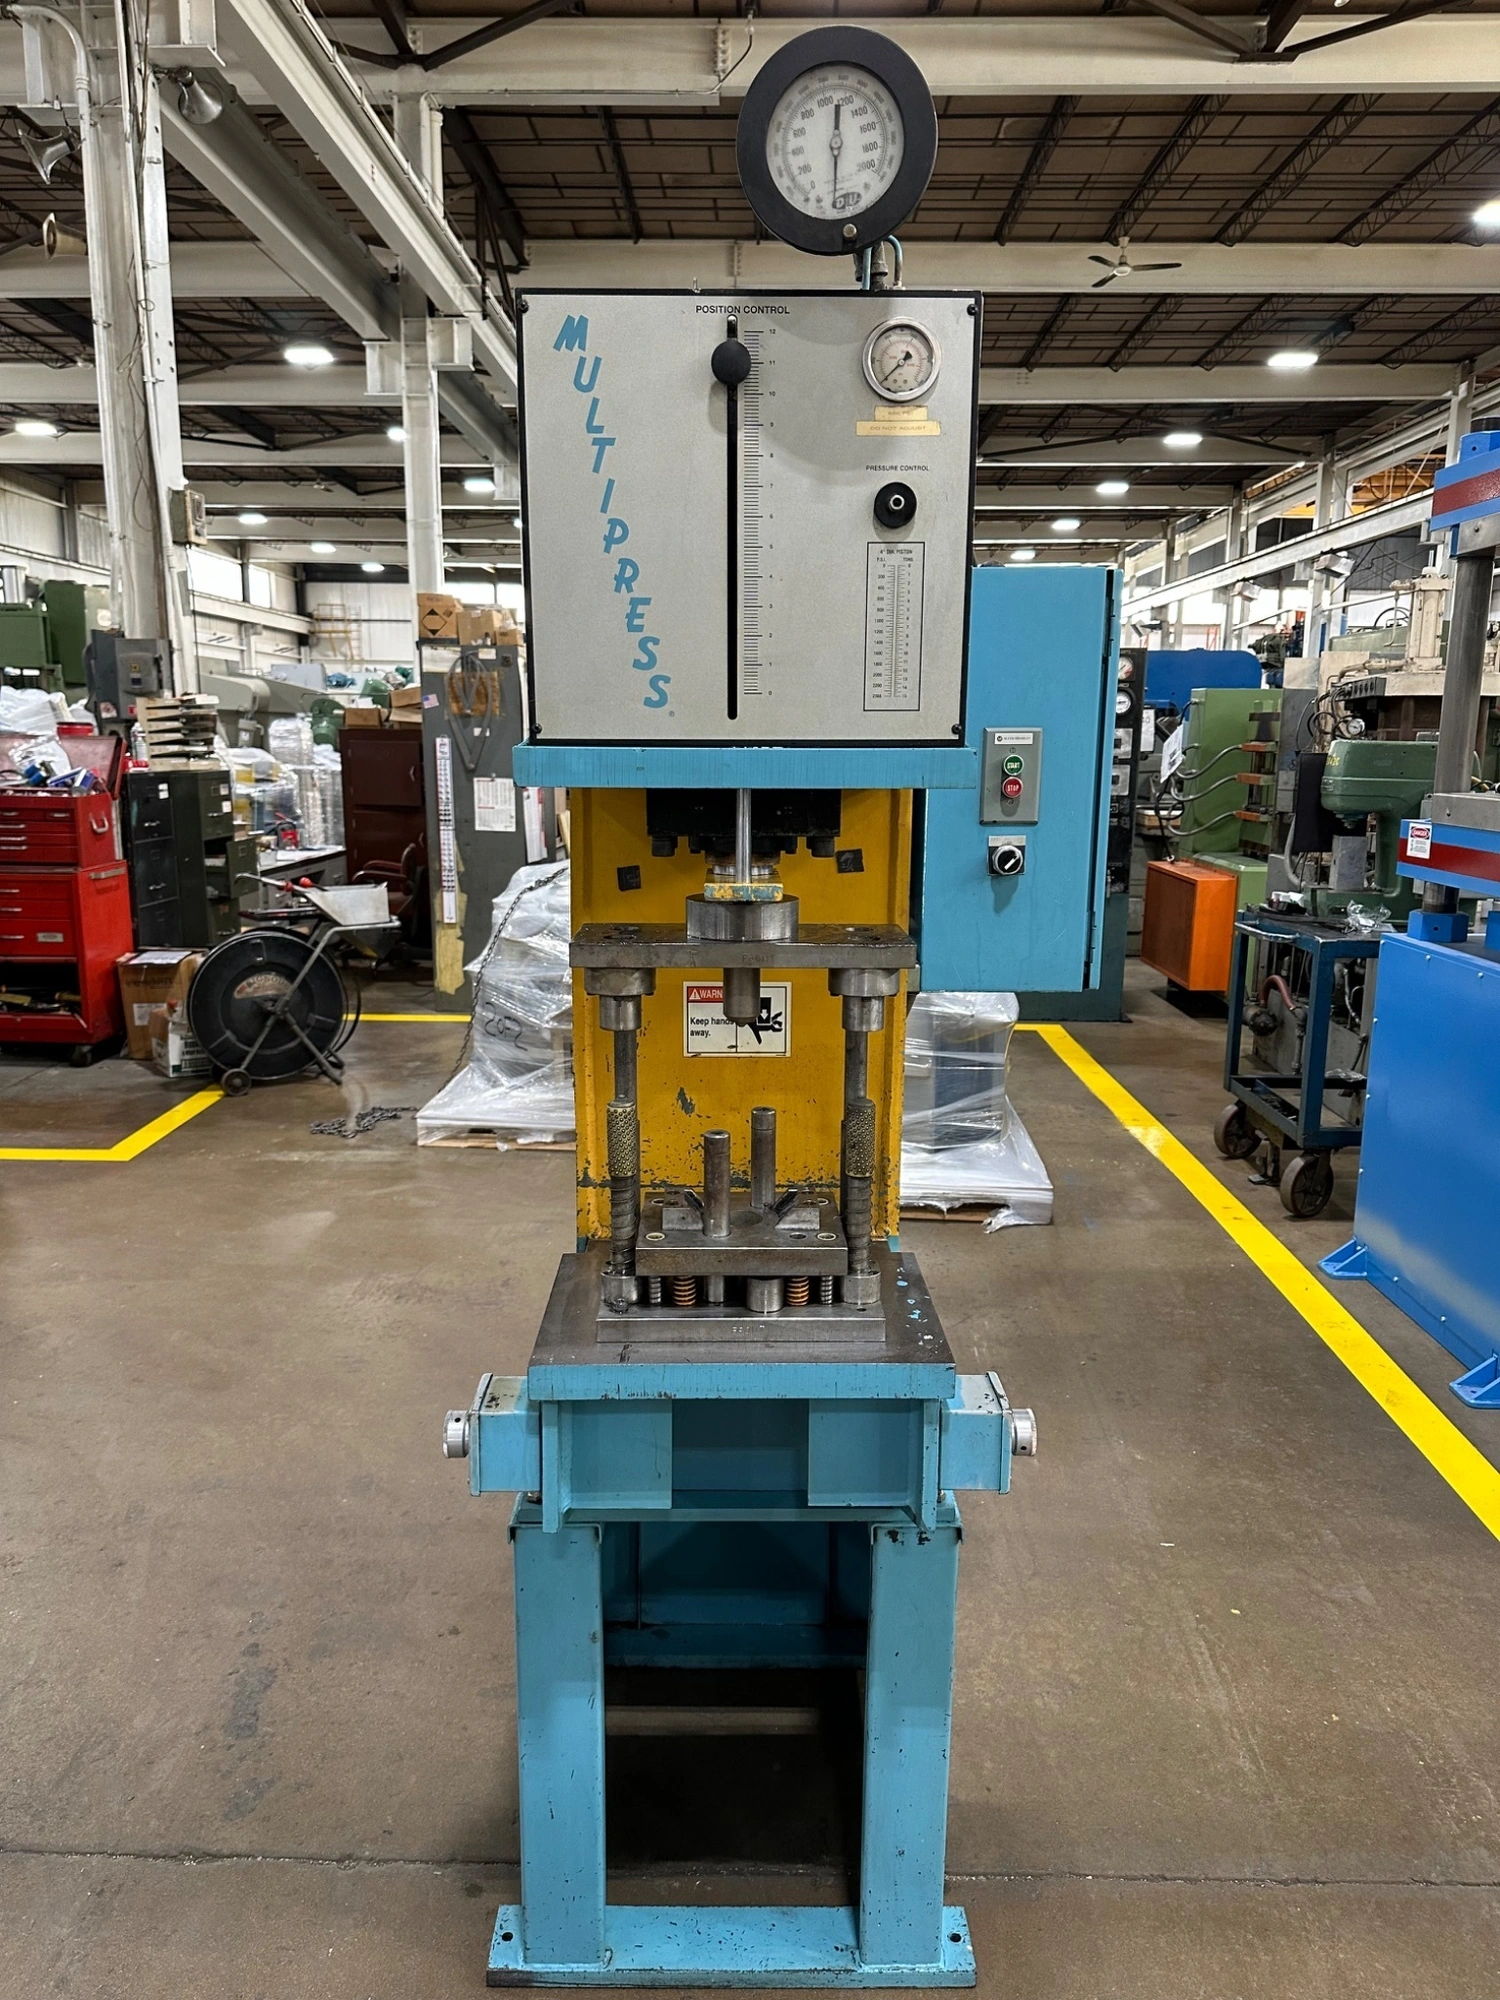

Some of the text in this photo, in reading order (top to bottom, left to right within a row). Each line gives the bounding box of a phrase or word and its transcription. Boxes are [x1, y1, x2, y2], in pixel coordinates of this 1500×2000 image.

[817, 95, 834, 109] 1000
[837, 94, 854, 107] 1200
[800, 108, 815, 121] 800
[851, 105, 868, 119] 1400
[793, 127, 806, 139] 600
[860, 121, 877, 135] 1600
[862, 141, 878, 154] 1800
[798, 163, 812, 176] 200
[856, 158, 876, 173] 2000
[810, 180, 816, 190] 0
[695, 305, 790, 314] POSITION CONTROL
[553, 314, 672, 708] MULTIPRESS
[1007, 784, 1020, 792] STOP
[700, 989, 723, 999] WARN
[690, 1016, 709, 1026] Keep
[690, 1029, 711, 1038] away.
